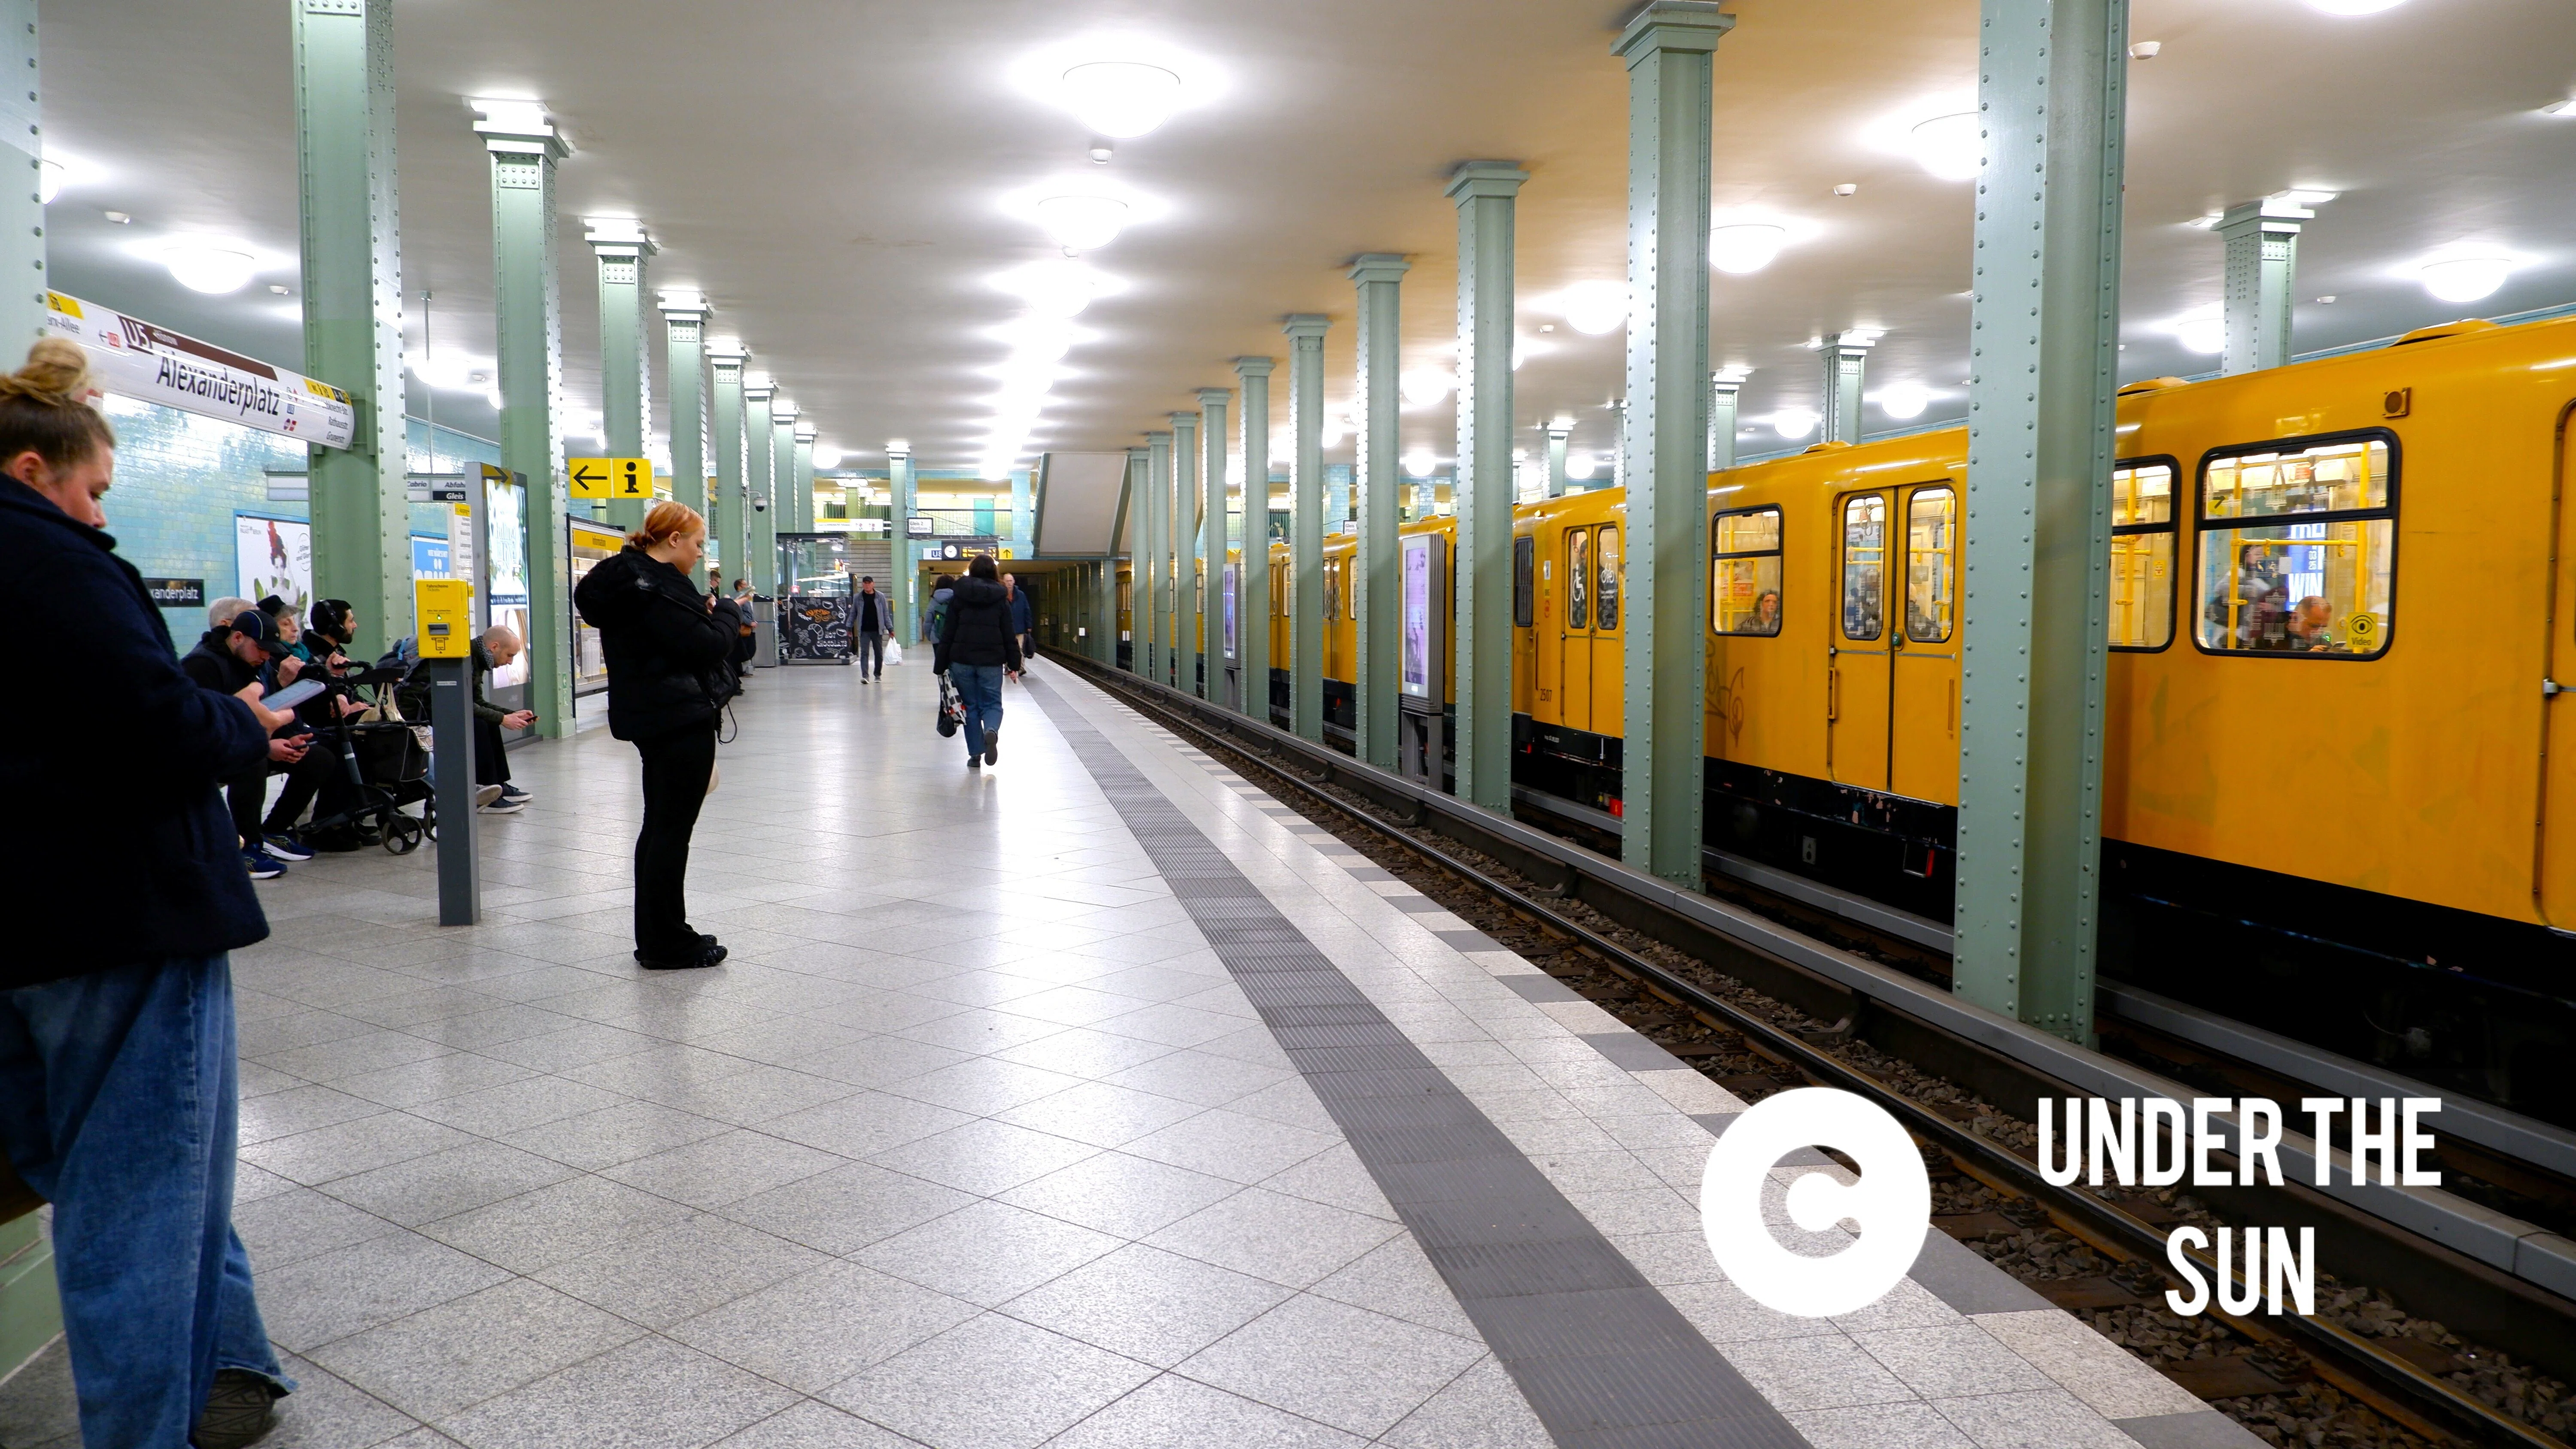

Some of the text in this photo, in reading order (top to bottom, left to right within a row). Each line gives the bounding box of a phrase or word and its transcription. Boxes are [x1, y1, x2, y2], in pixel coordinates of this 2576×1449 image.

[122, 318, 151, 349] U5
[156, 350, 280, 416] Alexanderplatz
[149, 585, 199, 602] xanderplatz
[2351, 637, 2372, 646] Video
[1540, 688, 1552, 702] 2507
